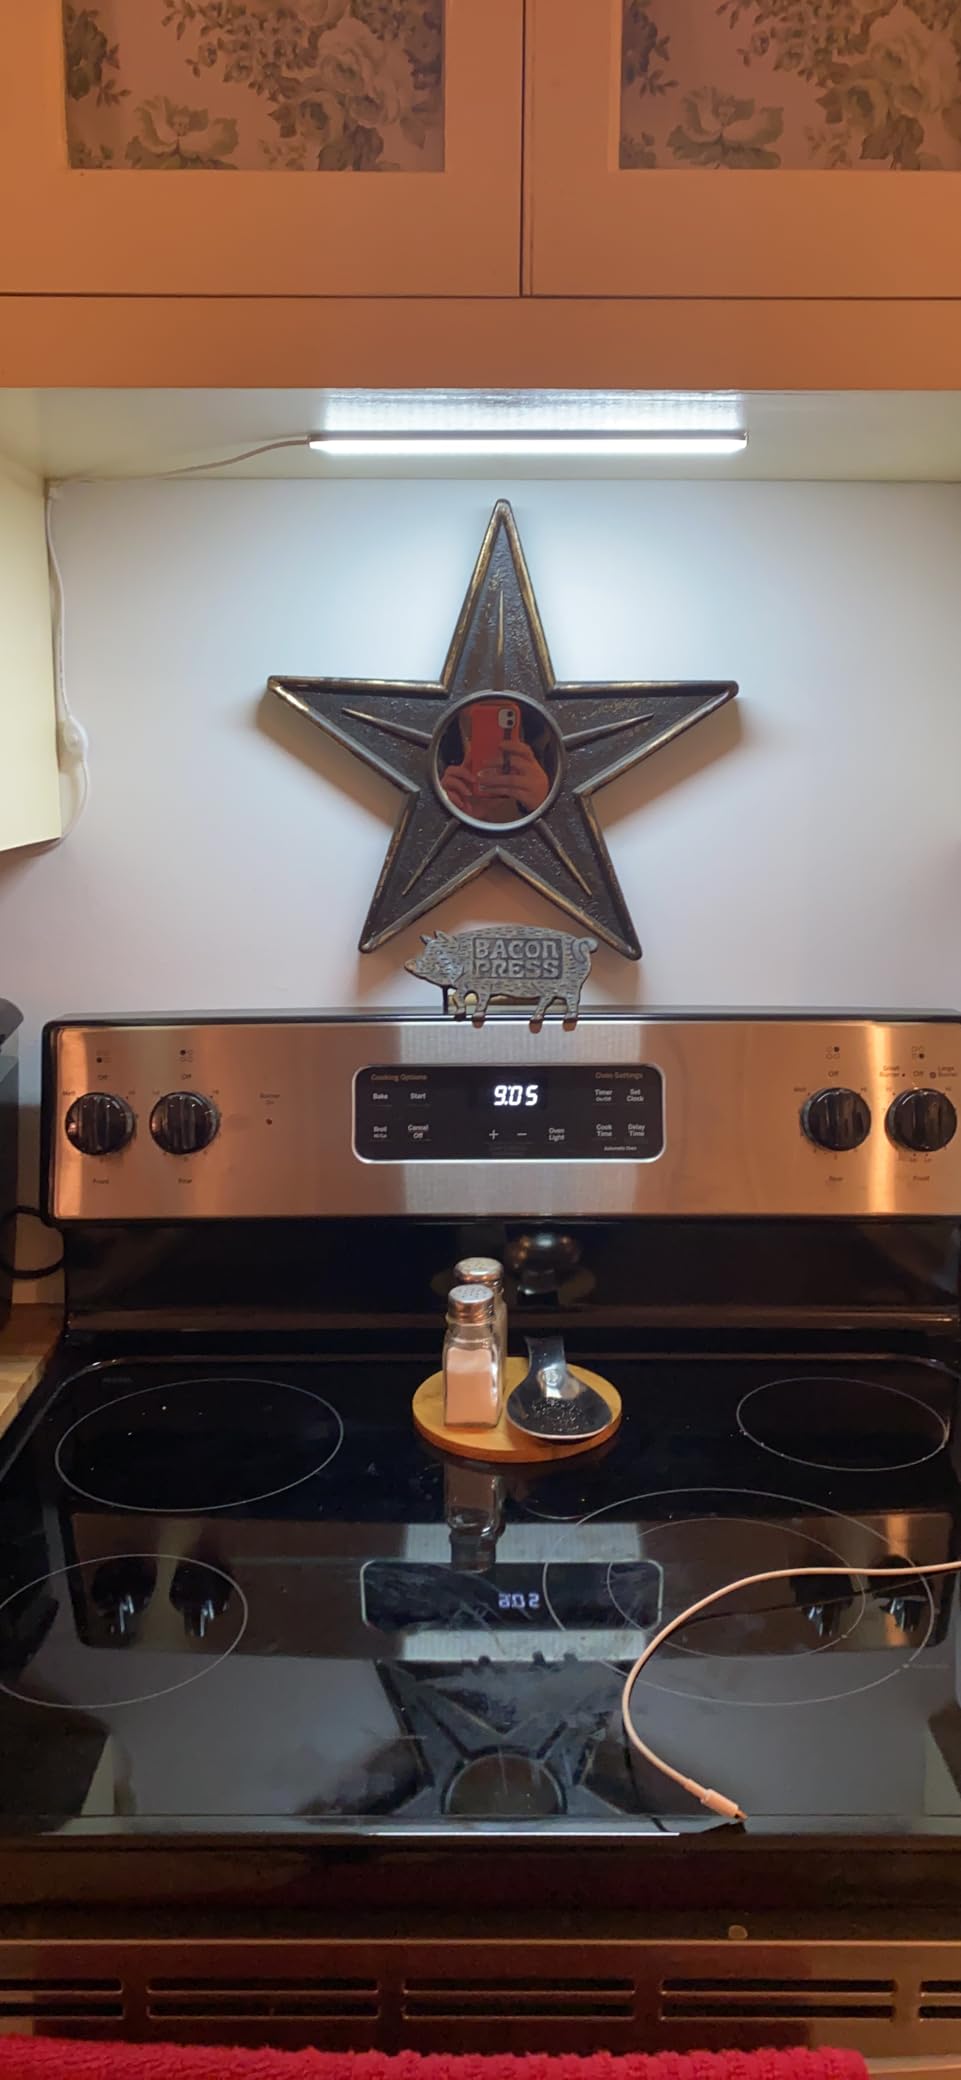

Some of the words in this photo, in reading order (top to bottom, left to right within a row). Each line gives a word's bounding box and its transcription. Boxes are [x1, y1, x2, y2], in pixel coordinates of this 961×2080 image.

[474, 937, 560, 960] BACON
[474, 959, 560, 979] PRESS
[370, 1073, 399, 1082] Cooking
[614, 1072, 644, 1080] Settings
[828, 1070, 840, 1078] Off
[372, 1092, 389, 1100] Bake
[410, 1092, 427, 1100] Start
[494, 1084, 539, 1106] 9:05
[594, 1088, 613, 1096] Timer
[407, 1124, 430, 1132] Cancel
[596, 1123, 613, 1131] Cook
[627, 1123, 646, 1132] Delay
[413, 1131, 424, 1139] Off
[548, 1134, 565, 1142] Light
